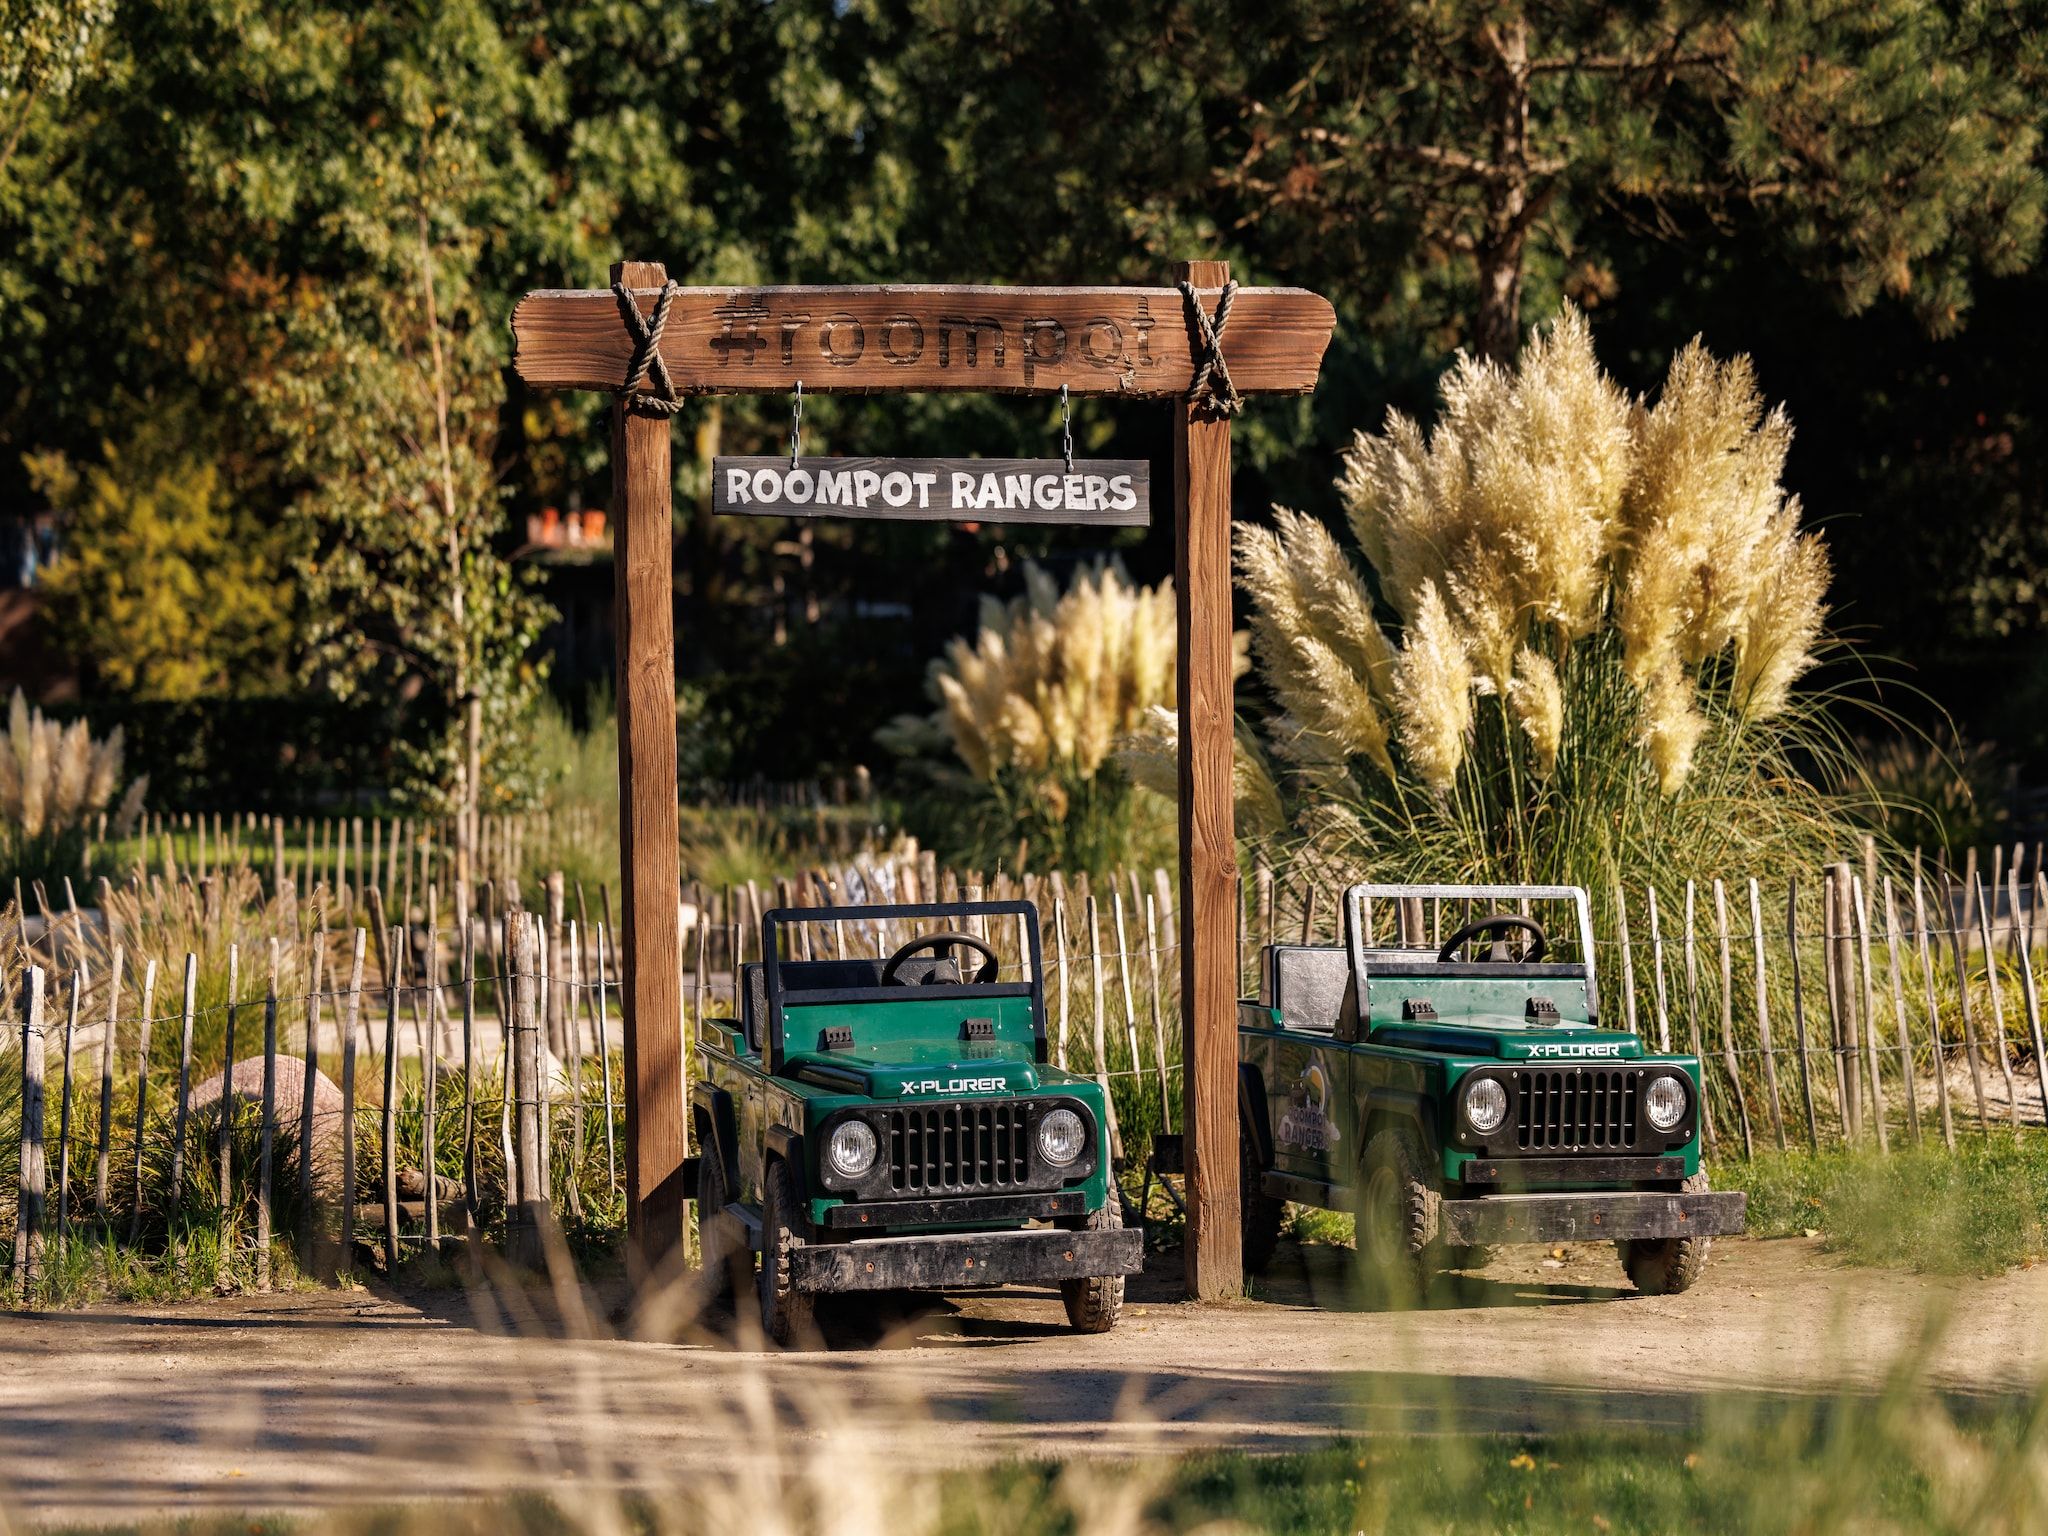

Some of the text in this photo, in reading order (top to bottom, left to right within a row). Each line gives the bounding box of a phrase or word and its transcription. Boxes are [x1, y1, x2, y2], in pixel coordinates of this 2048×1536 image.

[709, 292, 1156, 387] #roompot
[726, 468, 1137, 511] ROOMPOT RANGERS
[1528, 1044, 1620, 1057] X-PLORER
[900, 1077, 1007, 1095] X-PLORER
